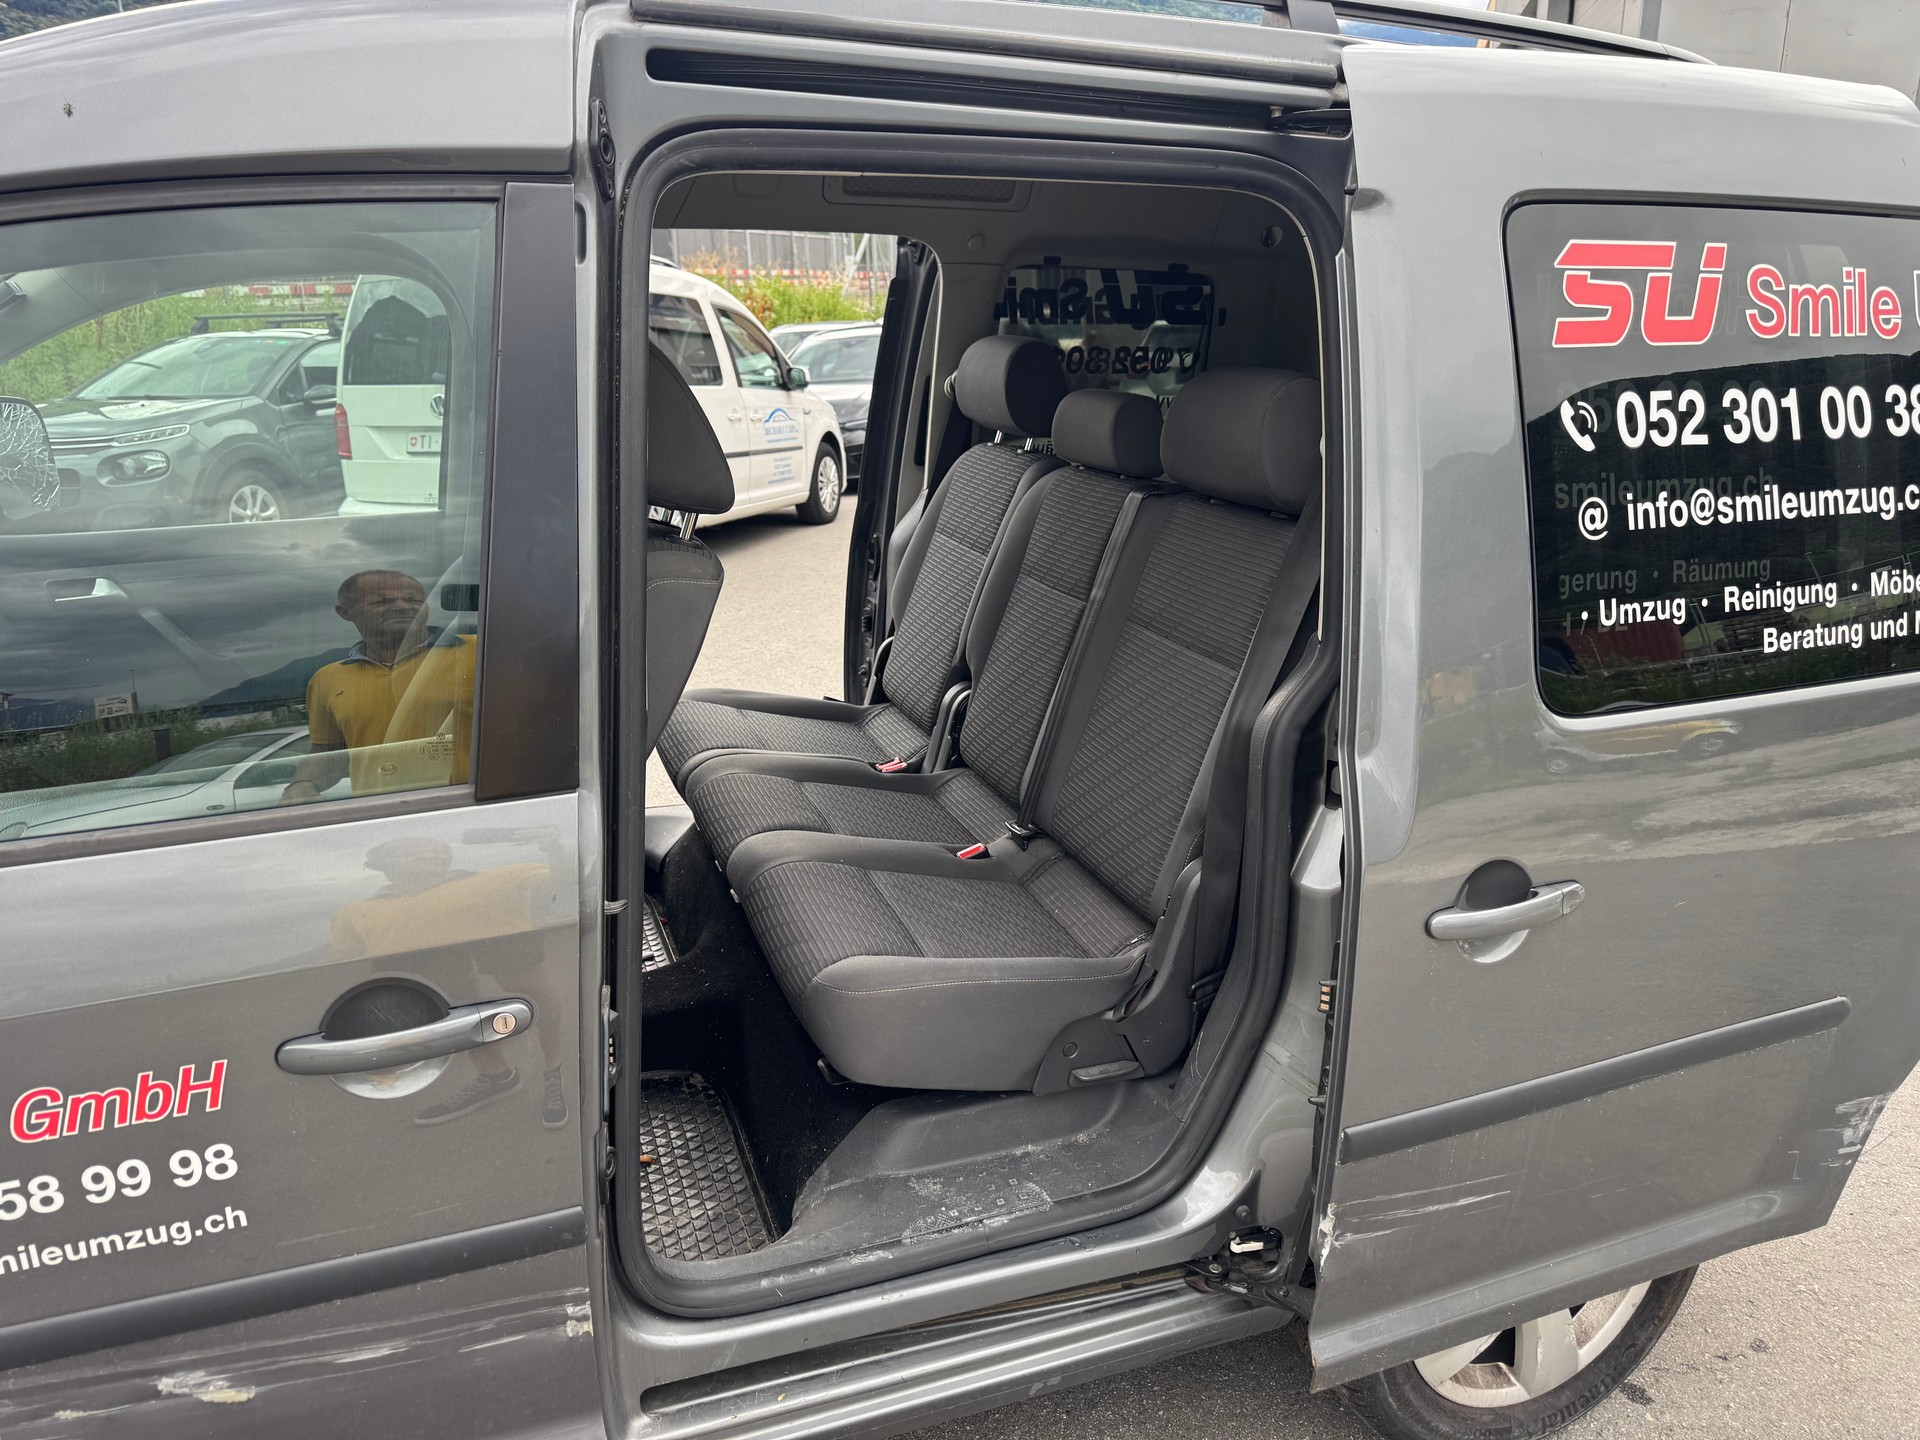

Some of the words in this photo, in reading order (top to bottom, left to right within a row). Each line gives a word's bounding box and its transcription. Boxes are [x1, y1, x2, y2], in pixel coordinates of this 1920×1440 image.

[1552, 239, 1728, 348] SU
[1745, 264, 1902, 340] Smile
[1616, 389, 1709, 449] 052
[1722, 387, 1801, 444] 301
[1819, 385, 1872, 439] 00
[1578, 496, 1608, 541] @
[1672, 558, 1772, 584] Räumung
[1599, 597, 1686, 627] Umzug
[1724, 580, 1837, 613] Reinigung
[1763, 622, 1862, 653] Beratung
[1870, 611, 1908, 640] und
[9, 1058, 229, 1144] GmbH
[81, 1159, 152, 1204] 99
[169, 1143, 239, 1189] 98
